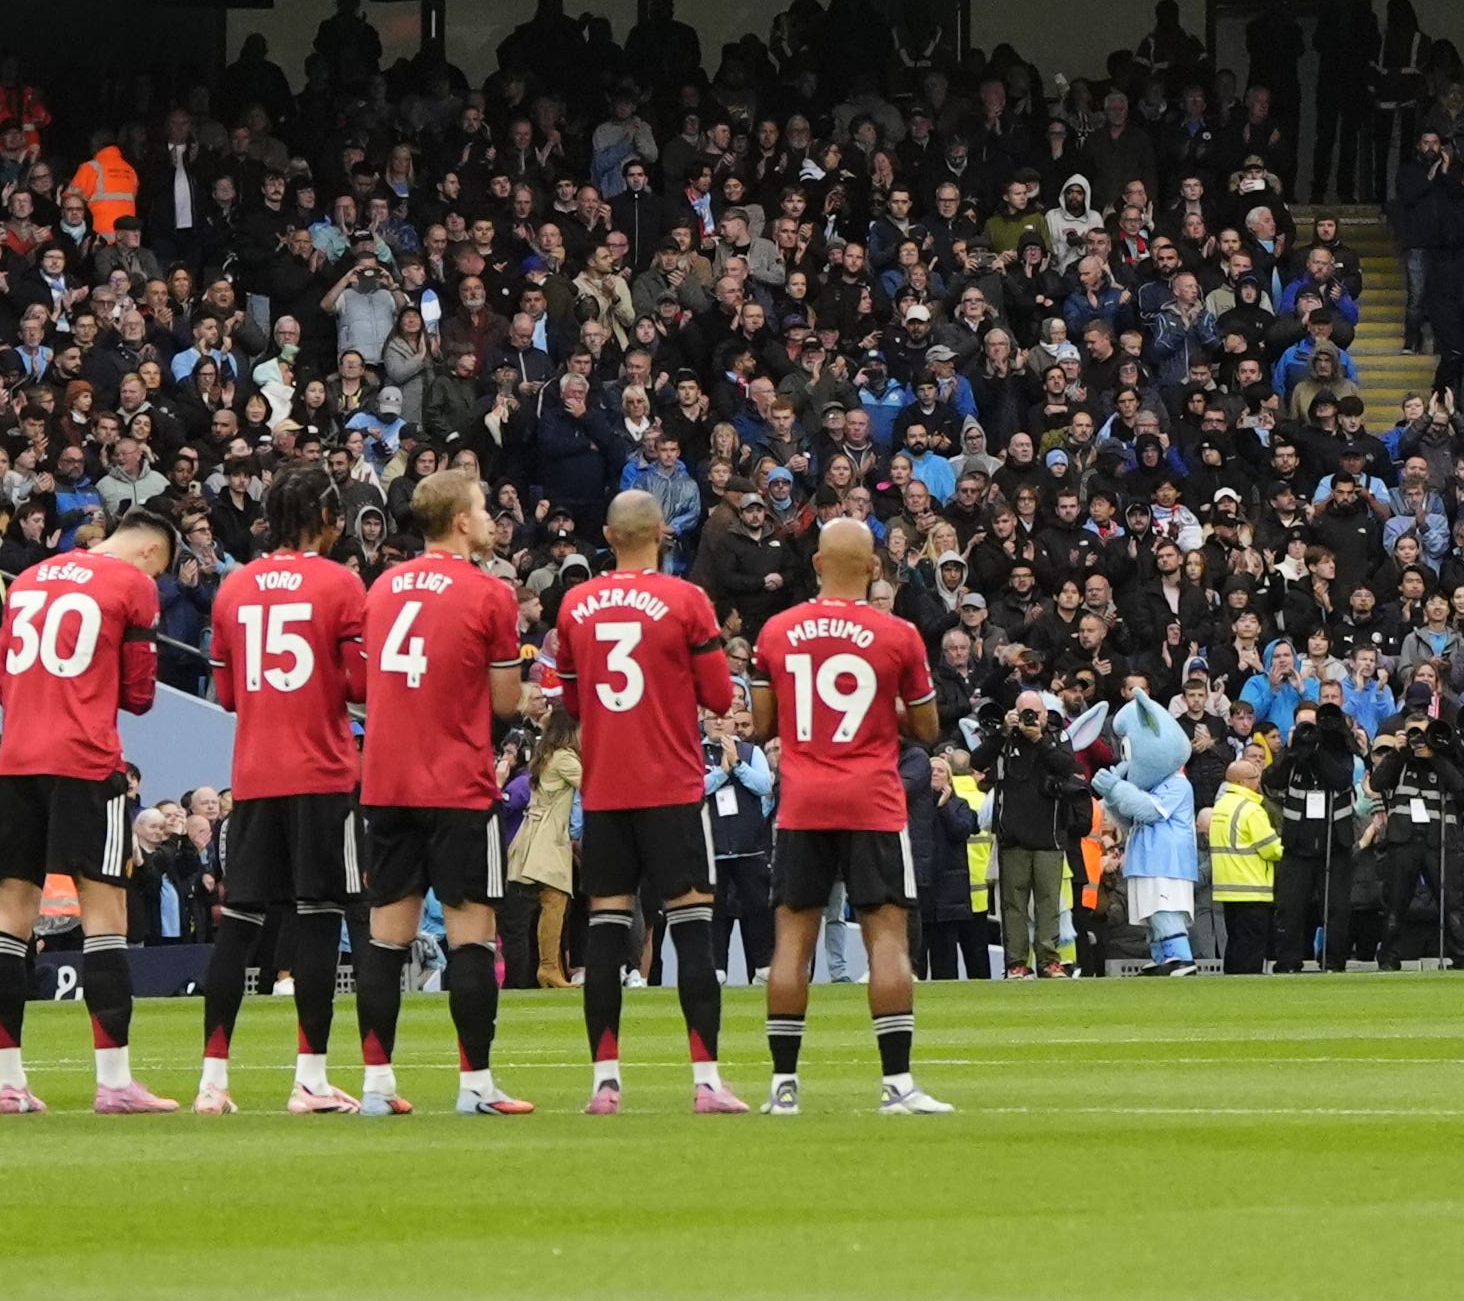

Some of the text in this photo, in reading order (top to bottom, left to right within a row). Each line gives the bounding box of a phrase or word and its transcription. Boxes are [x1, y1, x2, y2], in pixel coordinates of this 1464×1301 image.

[36, 562, 94, 585] ŠEŠKO
[254, 570, 303, 592] YORO
[391, 574, 454, 595] DE LIGT
[5, 589, 102, 679] 30
[570, 588, 669, 625] MAZRAOUI
[786, 619, 875, 649] MBEUMO
[237, 602, 315, 693] 15
[379, 600, 428, 689] 4
[595, 621, 644, 712] 3
[784, 653, 878, 743] 19
